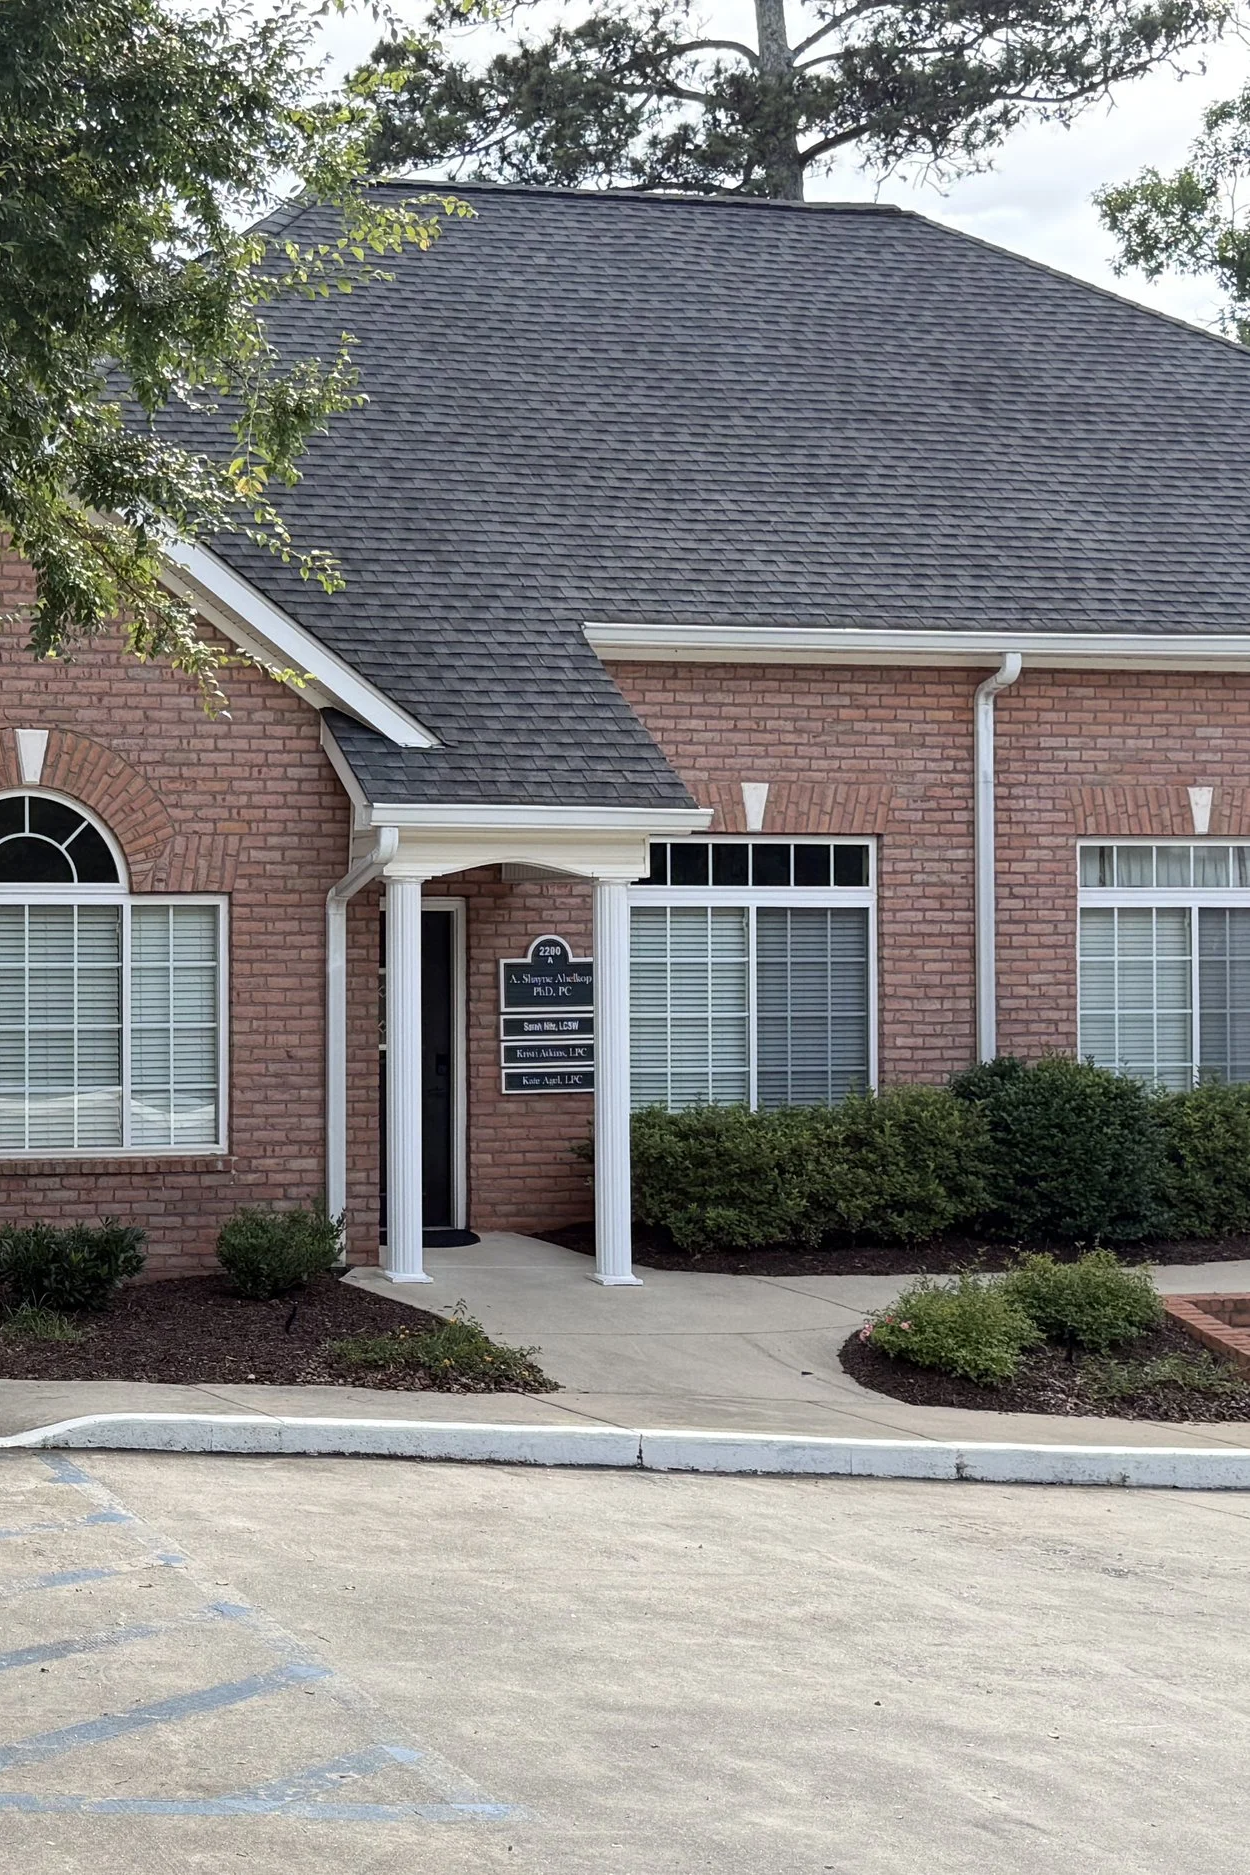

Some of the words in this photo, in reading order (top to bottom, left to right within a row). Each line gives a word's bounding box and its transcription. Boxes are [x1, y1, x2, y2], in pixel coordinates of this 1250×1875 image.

[539, 946, 562, 956] 2200
[547, 956, 554, 965] A
[509, 974, 521, 984] A.
[522, 973, 553, 986] Shayne
[555, 973, 593, 985] Abelkop
[558, 986, 573, 996] PC
[558, 1020, 579, 1031] LCSW
[516, 1049, 538, 1058] Kristi
[569, 1047, 588, 1058] LPC
[522, 1075, 541, 1085] Kate
[565, 1075, 583, 1085] LPC
